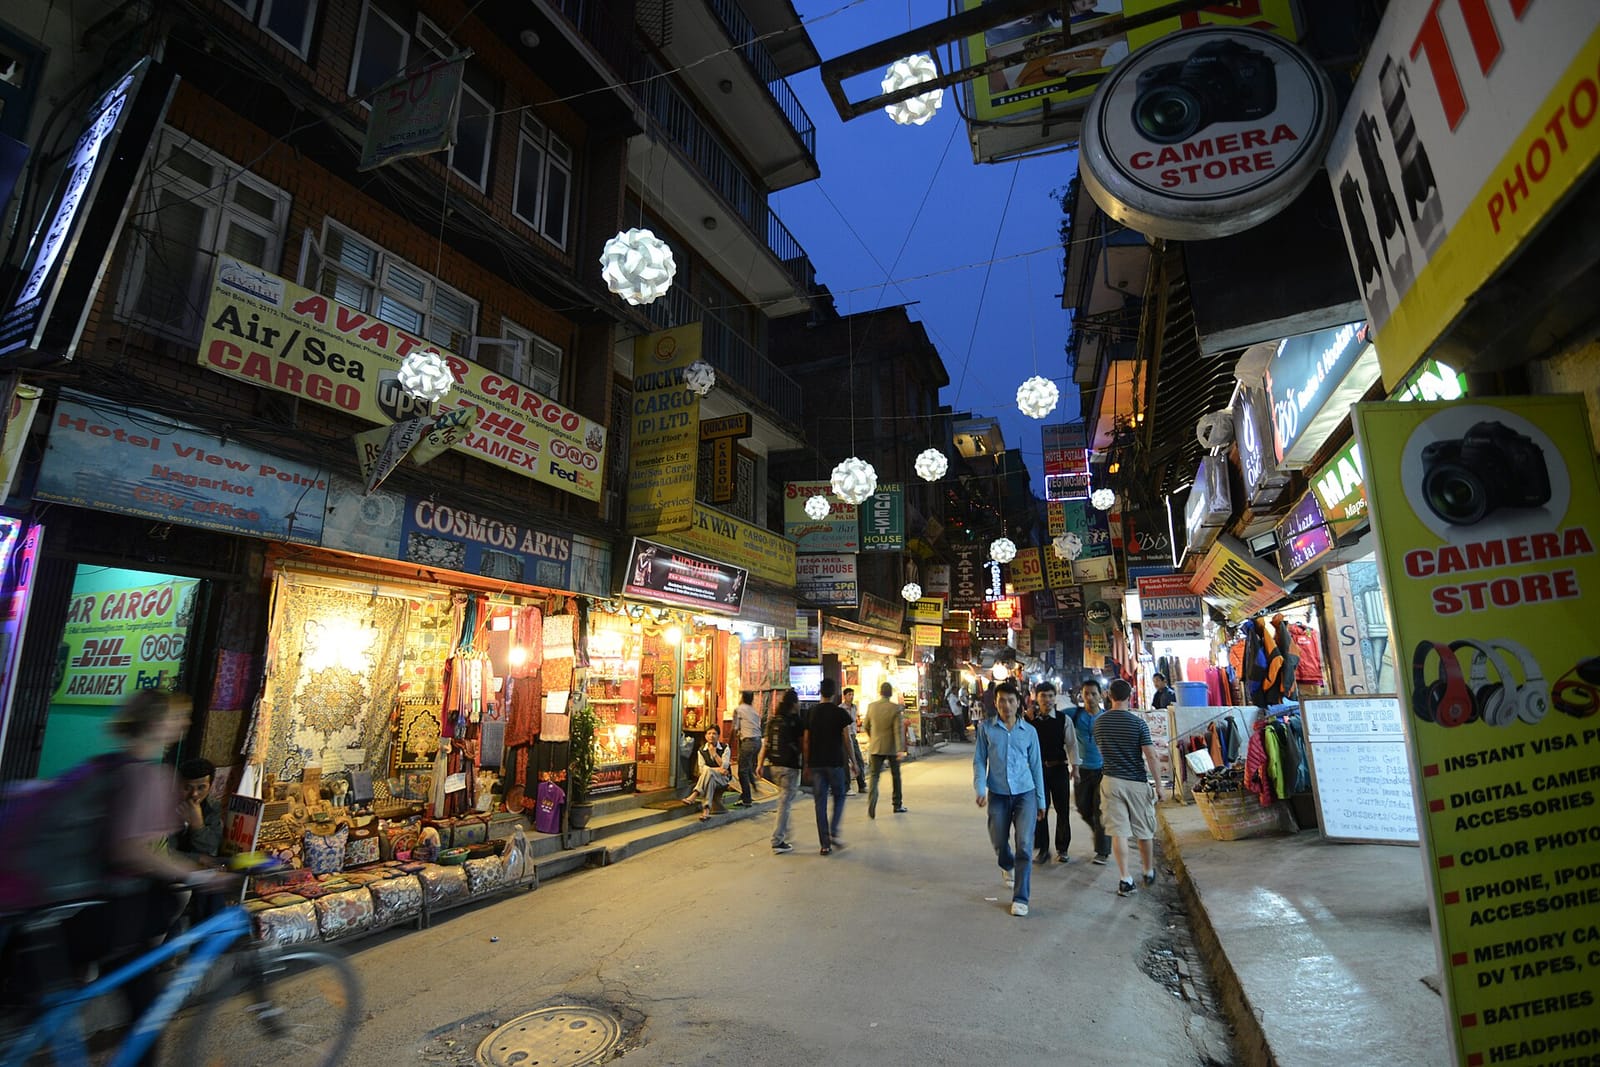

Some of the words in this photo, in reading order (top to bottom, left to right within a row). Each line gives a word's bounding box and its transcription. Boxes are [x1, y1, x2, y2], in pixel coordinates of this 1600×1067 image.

[999, 86, 1060, 105] Inside
[1129, 123, 1298, 171] CAMERA
[1160, 151, 1275, 188] STORE
[216, 287, 231, 297] Post
[232, 293, 245, 303] Box
[212, 305, 365, 382] Air/Sea
[208, 340, 361, 411] CARGO
[481, 375, 579, 431] CARGO
[634, 389, 695, 417] CARGO
[703, 416, 744, 436] QUICKWAY
[58, 412, 161, 452] Hotel
[173, 442, 250, 472] View
[259, 464, 326, 491] Point
[462, 432, 537, 471] RAMEX
[551, 441, 596, 469] TNT
[718, 441, 728, 485] CARGO
[1045, 451, 1063, 462] HOTEL
[1064, 449, 1085, 460] POTALA
[151, 463, 254, 498] Nagarkot
[550, 461, 594, 490] FedEx
[876, 484, 901, 492] AMEL
[133, 486, 187, 511] City
[191, 498, 261, 522] office
[1048, 488, 1088, 498] Restaurant
[415, 500, 517, 549] COSMOS
[520, 528, 569, 561] ARTS
[874, 493, 891, 534] GUEST
[864, 535, 902, 543] HOUSE
[1405, 527, 1594, 578] CAMERA
[823, 564, 853, 574] HOUSE
[957, 552, 974, 596] TATTOO
[1023, 559, 1040, 576] 50
[834, 582, 855, 590] SPA
[1432, 570, 1579, 616] STORE
[100, 587, 173, 621] CARGO
[1142, 597, 1197, 611] PHARMACY
[80, 637, 125, 667] DHL
[67, 674, 127, 695] ARAMEX
[1444, 743, 1526, 773] INSTANT
[1530, 731, 1578, 755] VISA
[1450, 781, 1529, 809] DIGITAL
[1454, 791, 1595, 832] ACCESSORIES
[1460, 840, 1529, 867] COLOR
[1535, 826, 1600, 853] PHOTO
[1465, 872, 1551, 902] iPHONE,
[1473, 930, 1567, 963] MEMORY
[1478, 966, 1505, 989] DV
[1510, 954, 1582, 982] TAPES,
[1483, 989, 1595, 1026] BATTERIES
